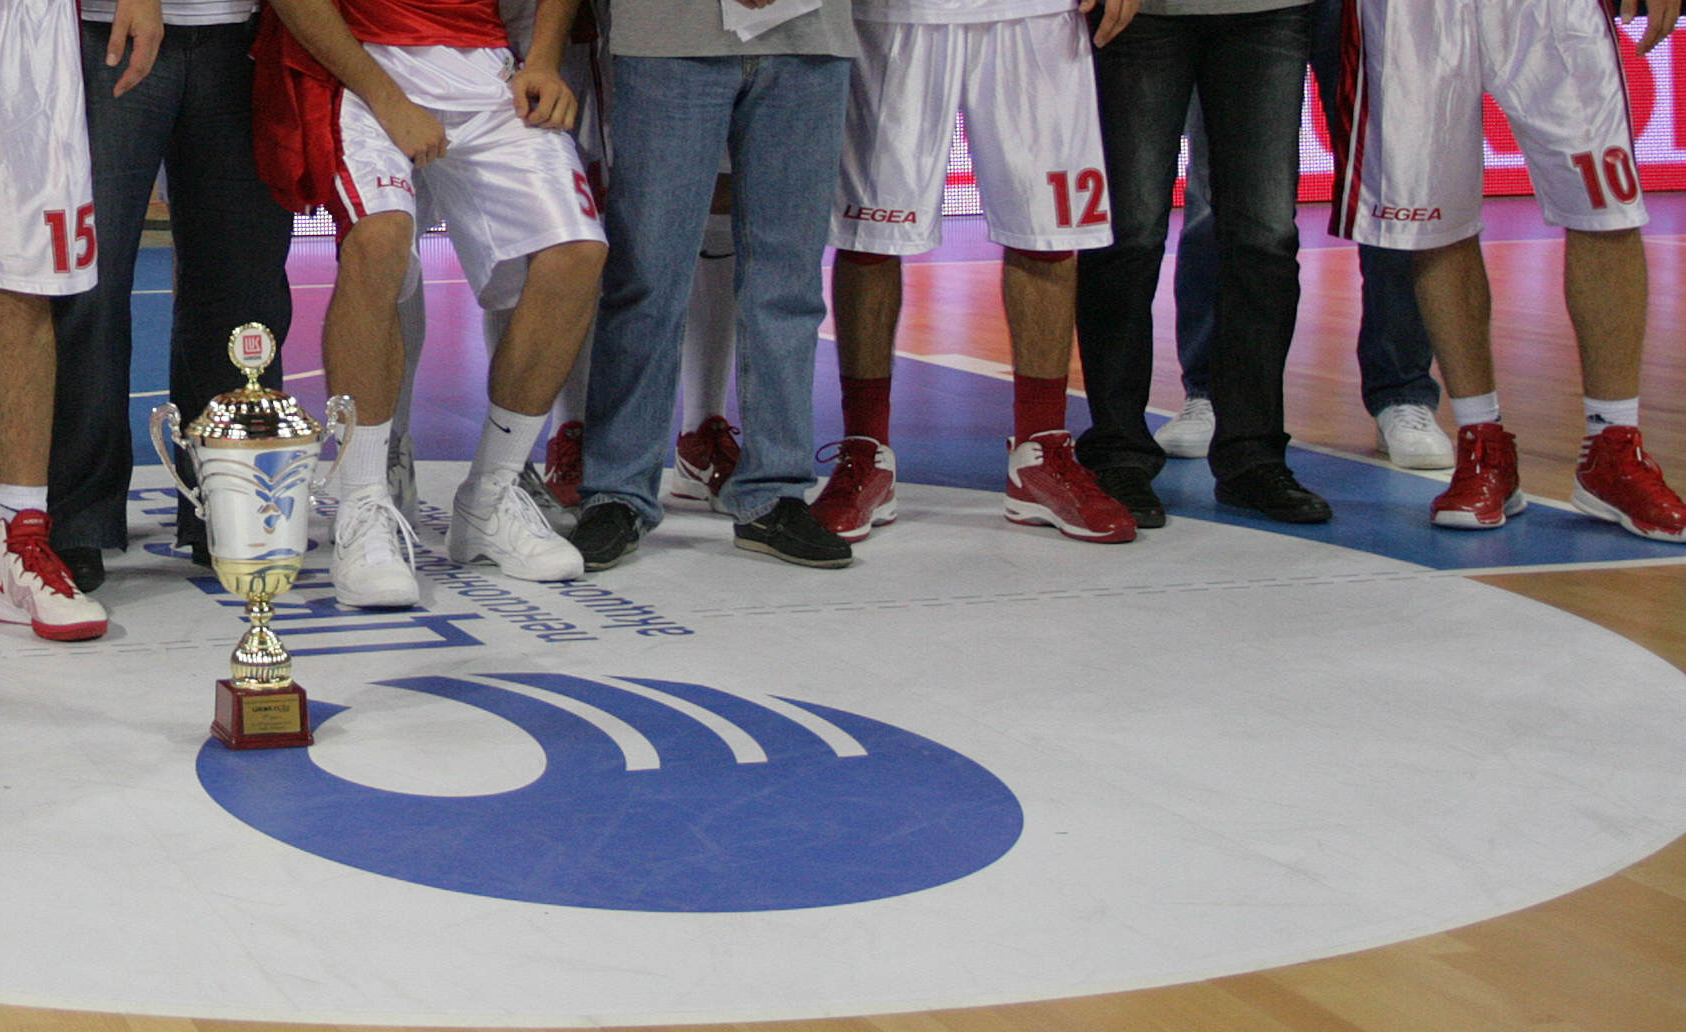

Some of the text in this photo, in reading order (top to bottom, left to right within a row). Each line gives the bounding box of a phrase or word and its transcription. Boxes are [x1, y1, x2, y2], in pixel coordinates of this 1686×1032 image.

[376, 175, 415, 198] LEG
[1046, 167, 1109, 229] 12
[1570, 145, 1640, 211] 10
[43, 201, 98, 274] 15
[843, 204, 917, 224] LEGEA
[1372, 205, 1442, 222] LEGEA
[538, 579, 696, 637] акцион
